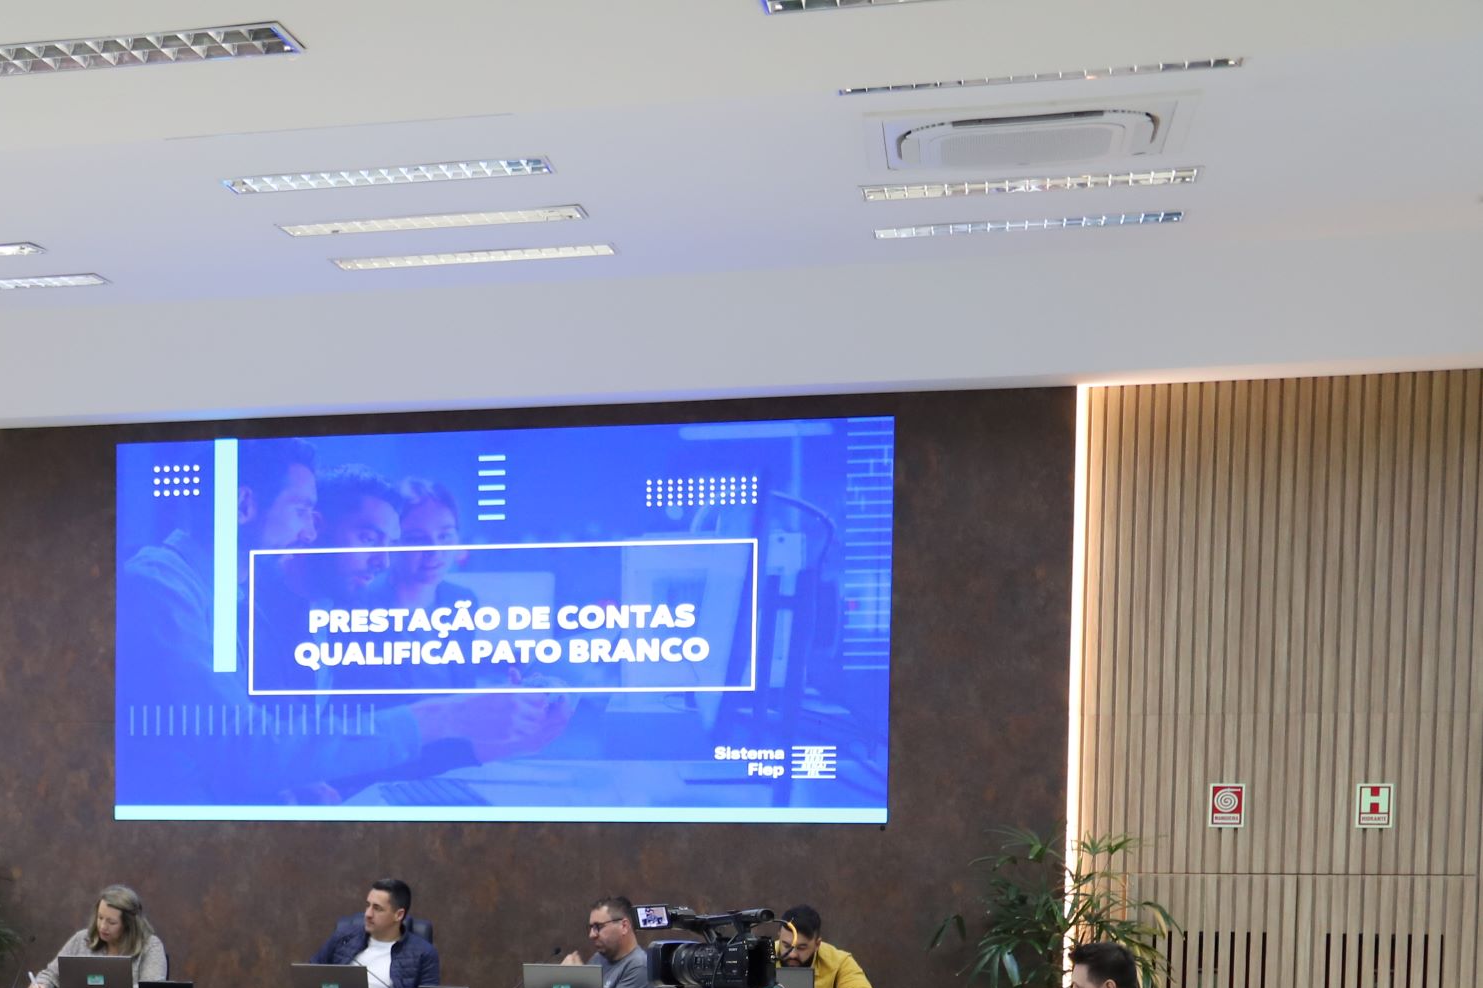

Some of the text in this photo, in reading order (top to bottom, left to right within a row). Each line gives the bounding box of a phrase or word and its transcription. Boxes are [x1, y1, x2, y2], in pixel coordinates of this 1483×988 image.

[309, 600, 696, 638] PRESTAÇÃO DE CONTAS
[294, 637, 710, 671] QUALIFICA PATO BRANCO
[714, 746, 785, 760] Sistema
[748, 762, 785, 778] Fiep
